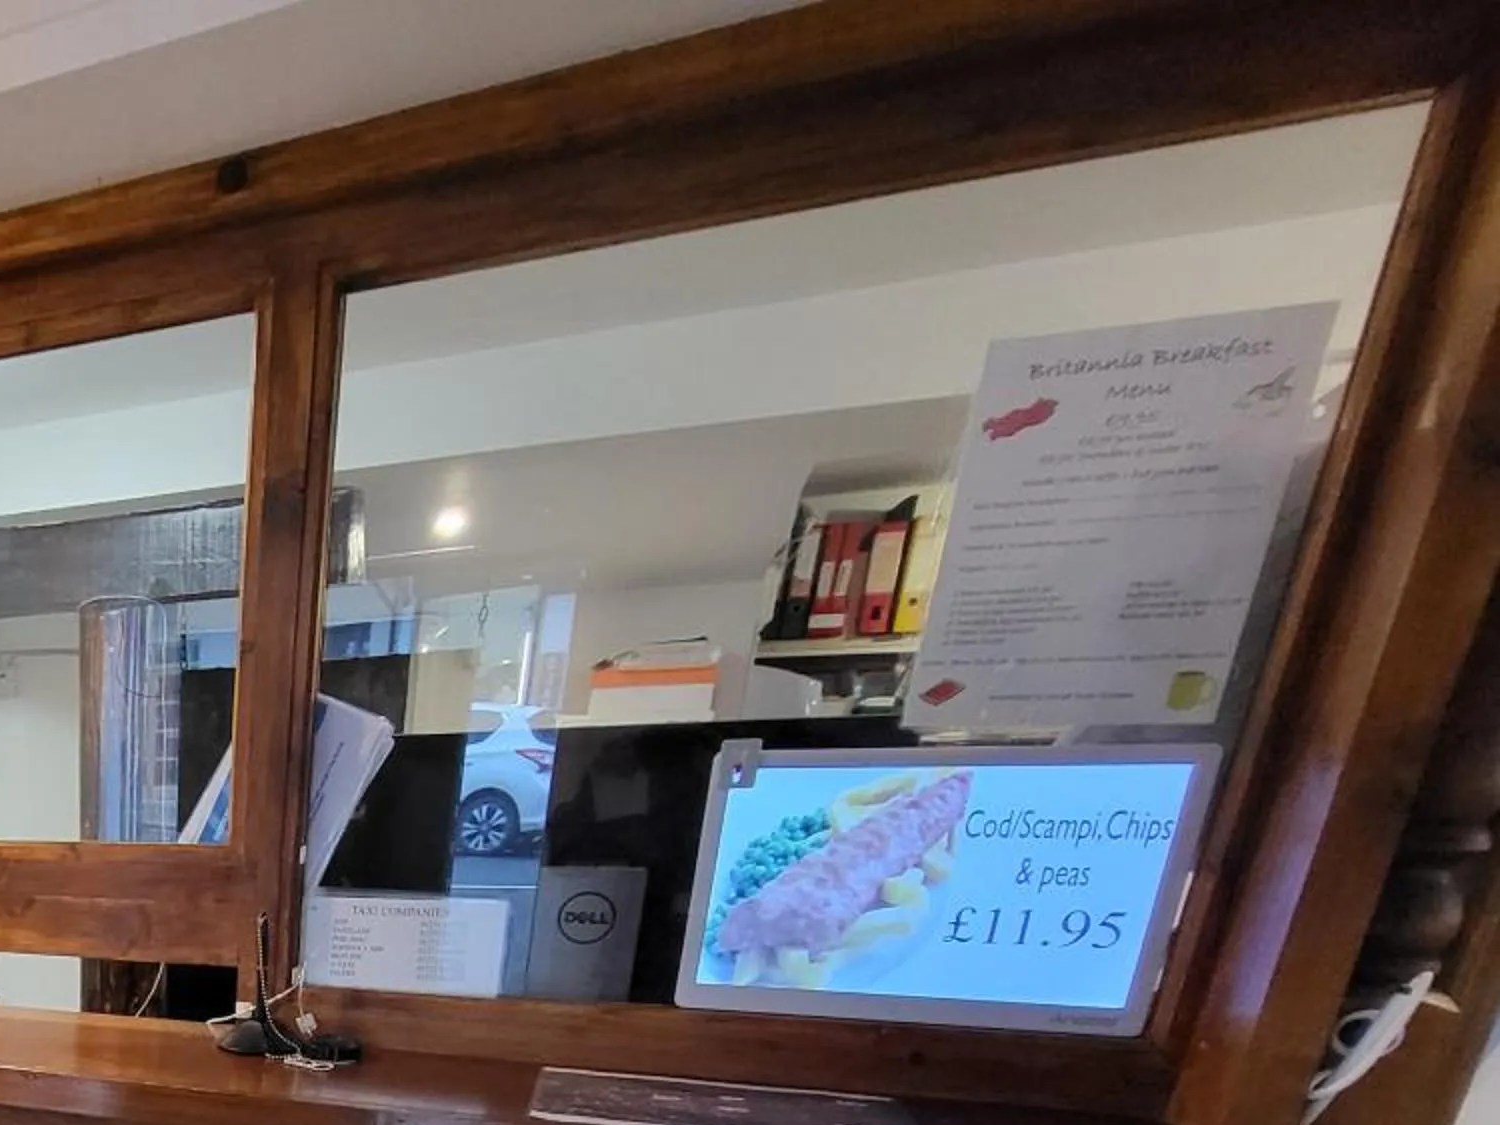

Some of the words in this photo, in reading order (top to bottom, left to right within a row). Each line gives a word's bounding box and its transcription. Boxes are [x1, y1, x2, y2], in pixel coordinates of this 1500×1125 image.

[1029, 353, 1144, 380] Britannia
[1153, 337, 1274, 367] Breakfast
[1104, 382, 1172, 401] Menu
[1015, 857, 1033, 885] &
[1038, 865, 1091, 893] peas
[564, 911, 610, 925] DELL
[943, 906, 1127, 949] £11.95
